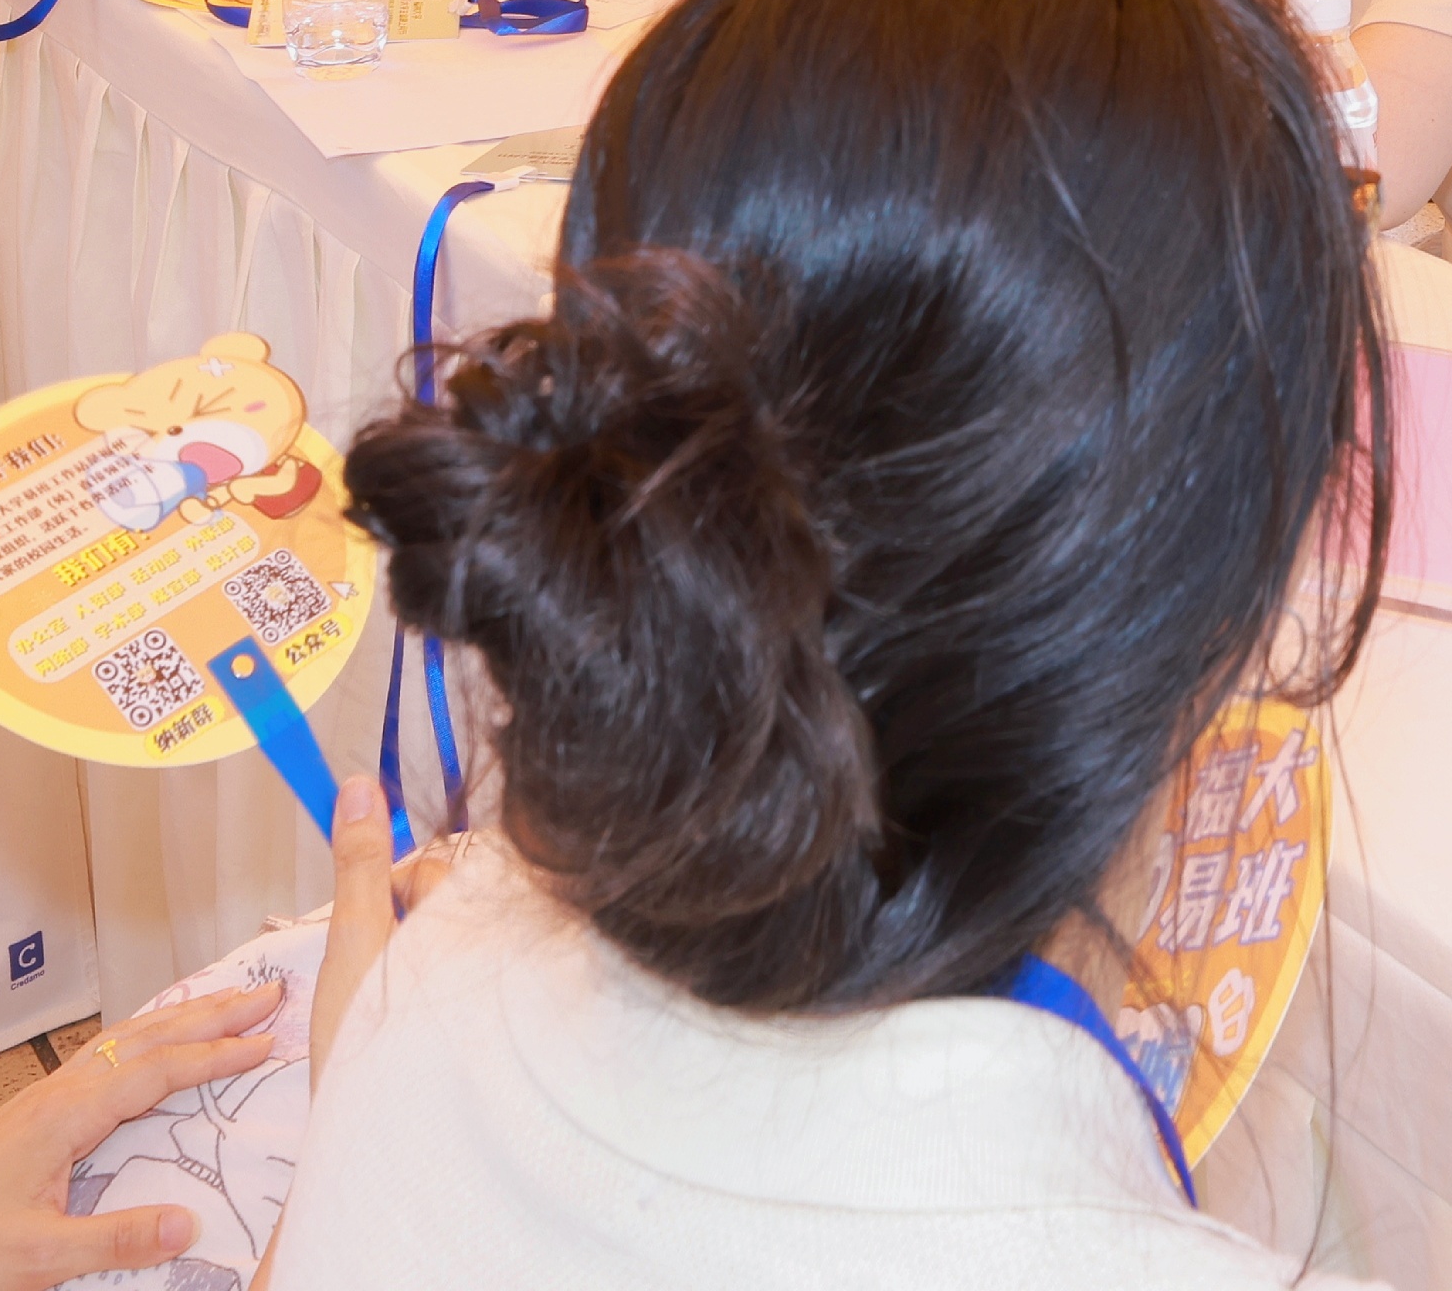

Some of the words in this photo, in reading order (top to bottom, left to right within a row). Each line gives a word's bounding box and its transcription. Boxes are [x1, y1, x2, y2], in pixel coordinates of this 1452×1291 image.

[285, 619, 345, 666] 公众号
[153, 702, 216, 750] 纳新群
[1184, 728, 1317, 841] 福大
[1156, 839, 1308, 953] 易班
[10, 968, 46, 991] Credamo
